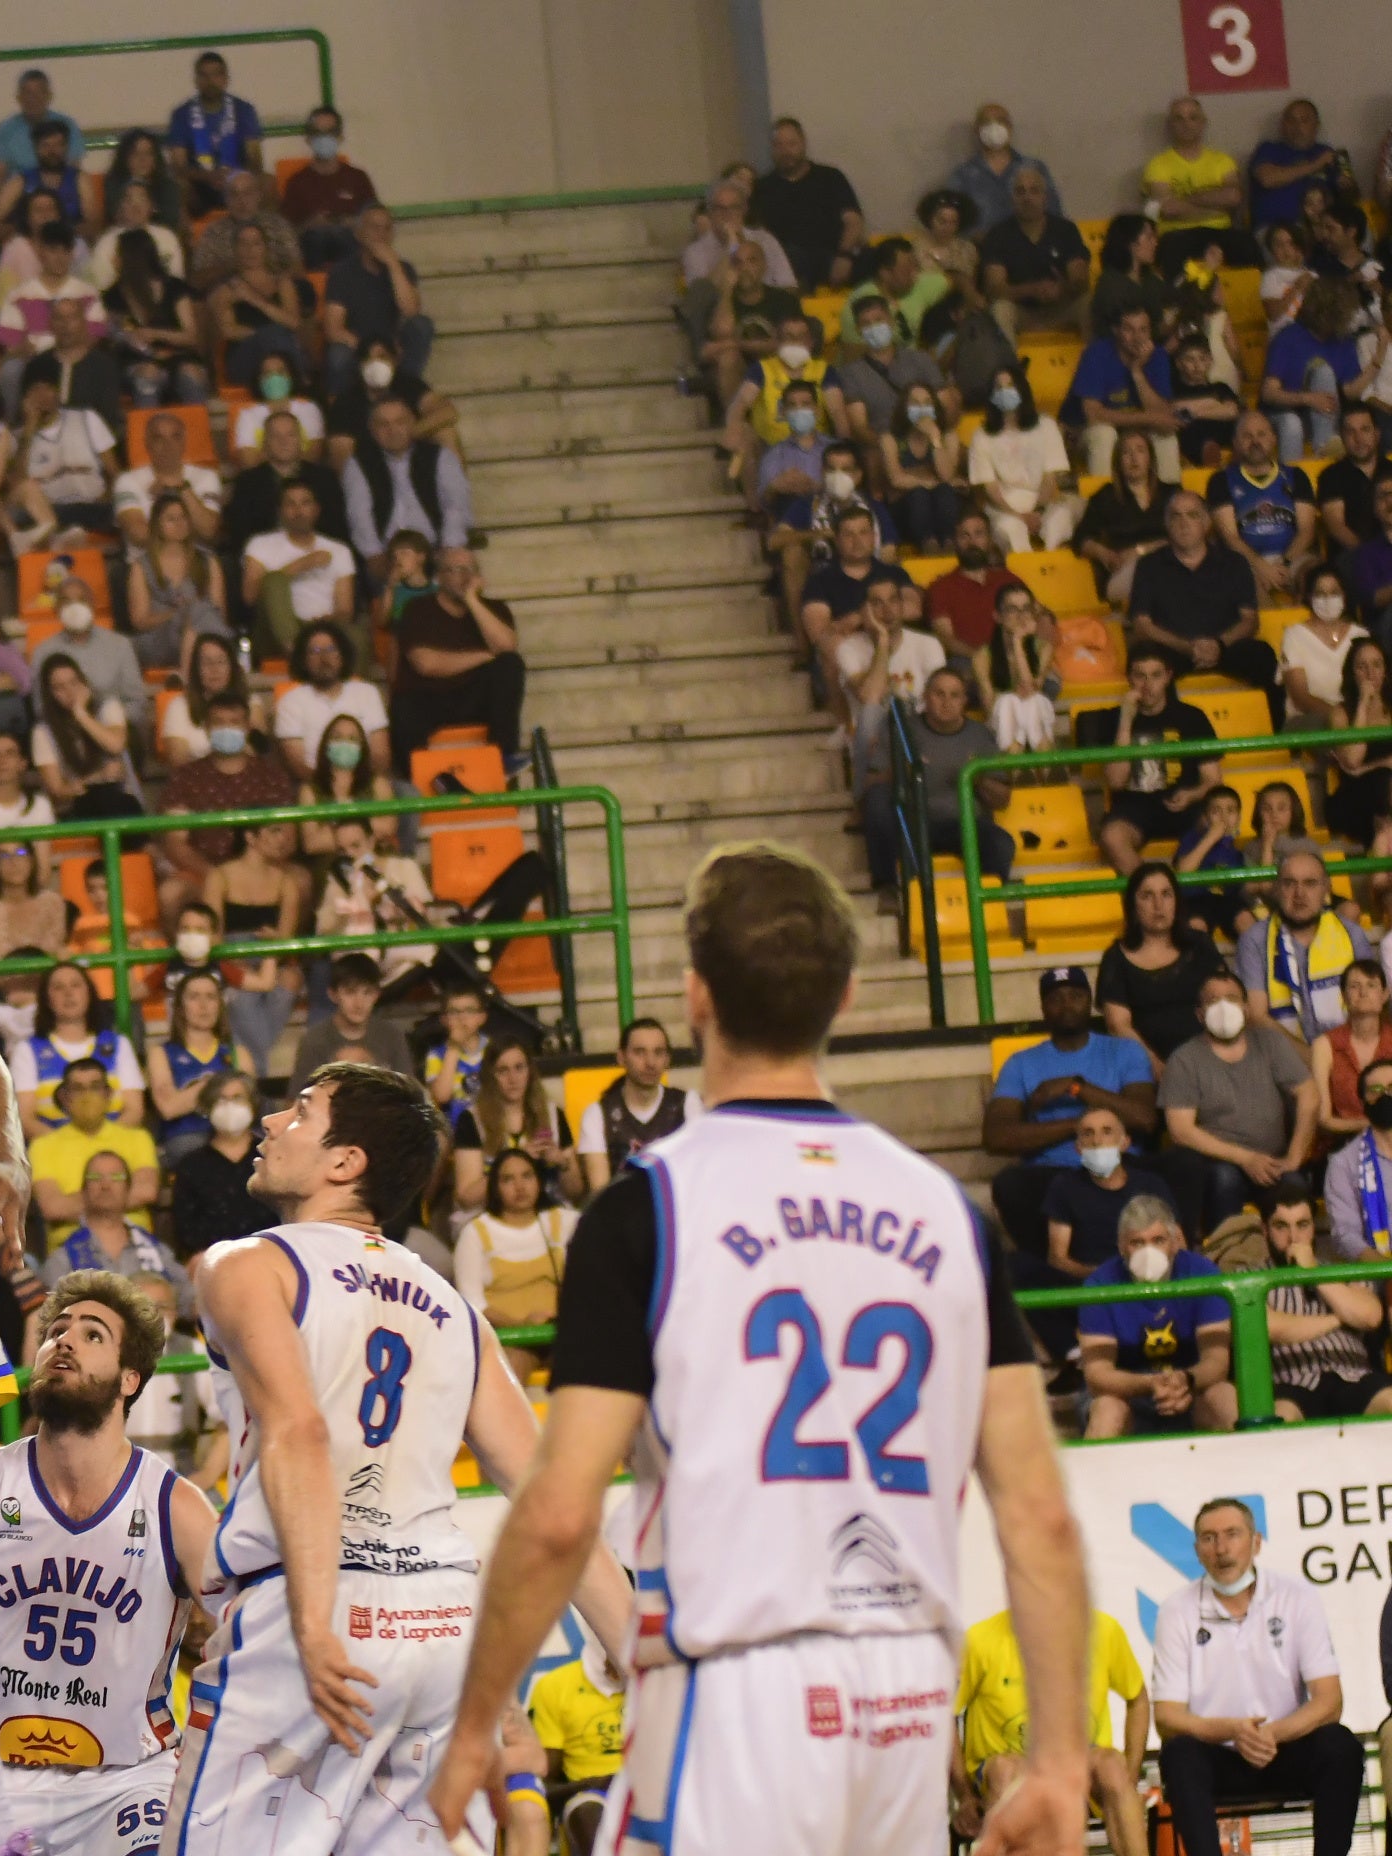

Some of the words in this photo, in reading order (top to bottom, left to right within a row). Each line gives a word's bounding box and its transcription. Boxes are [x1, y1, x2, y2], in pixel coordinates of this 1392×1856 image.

[1208, 6, 1257, 77] 3
[720, 1224, 777, 1267] B.
[778, 1197, 942, 1284] GARCÍA
[358, 1326, 412, 1449] 8
[743, 1287, 934, 1496] 22
[23, 1604, 98, 1666] 55
[0, 1666, 60, 1702] Monte
[64, 1677, 108, 1708] Real
